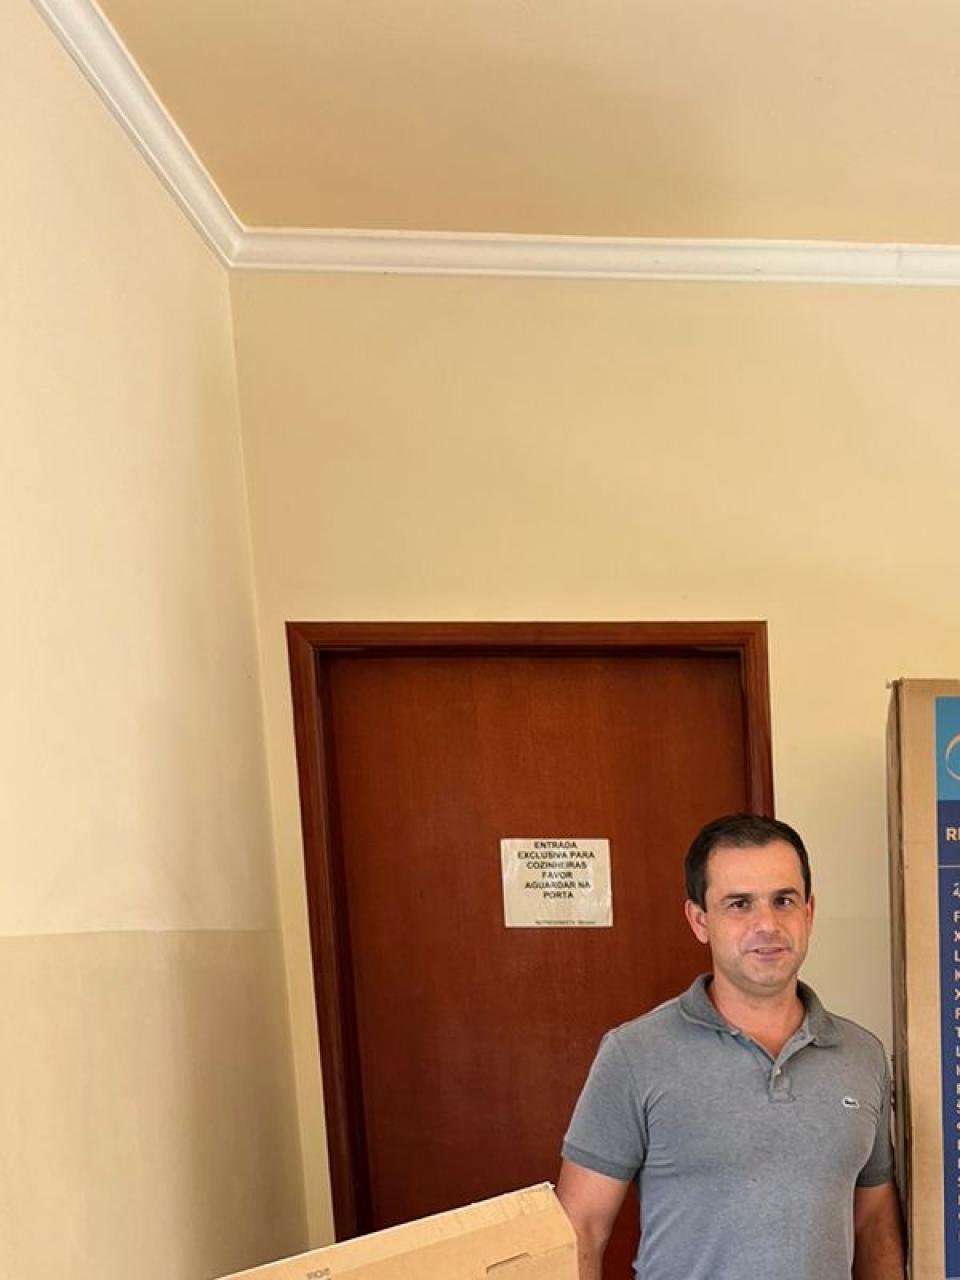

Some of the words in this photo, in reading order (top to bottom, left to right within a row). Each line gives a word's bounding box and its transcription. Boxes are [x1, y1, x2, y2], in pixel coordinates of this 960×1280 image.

[534, 841, 577, 849] ENTRADA
[518, 851, 568, 859] EXCLUSIVA
[570, 851, 595, 859] PARA
[526, 861, 587, 870] COZINHEIRAS
[525, 881, 576, 889] AGUARDAR
[578, 881, 591, 889] NA
[543, 891, 574, 899] PORTA
